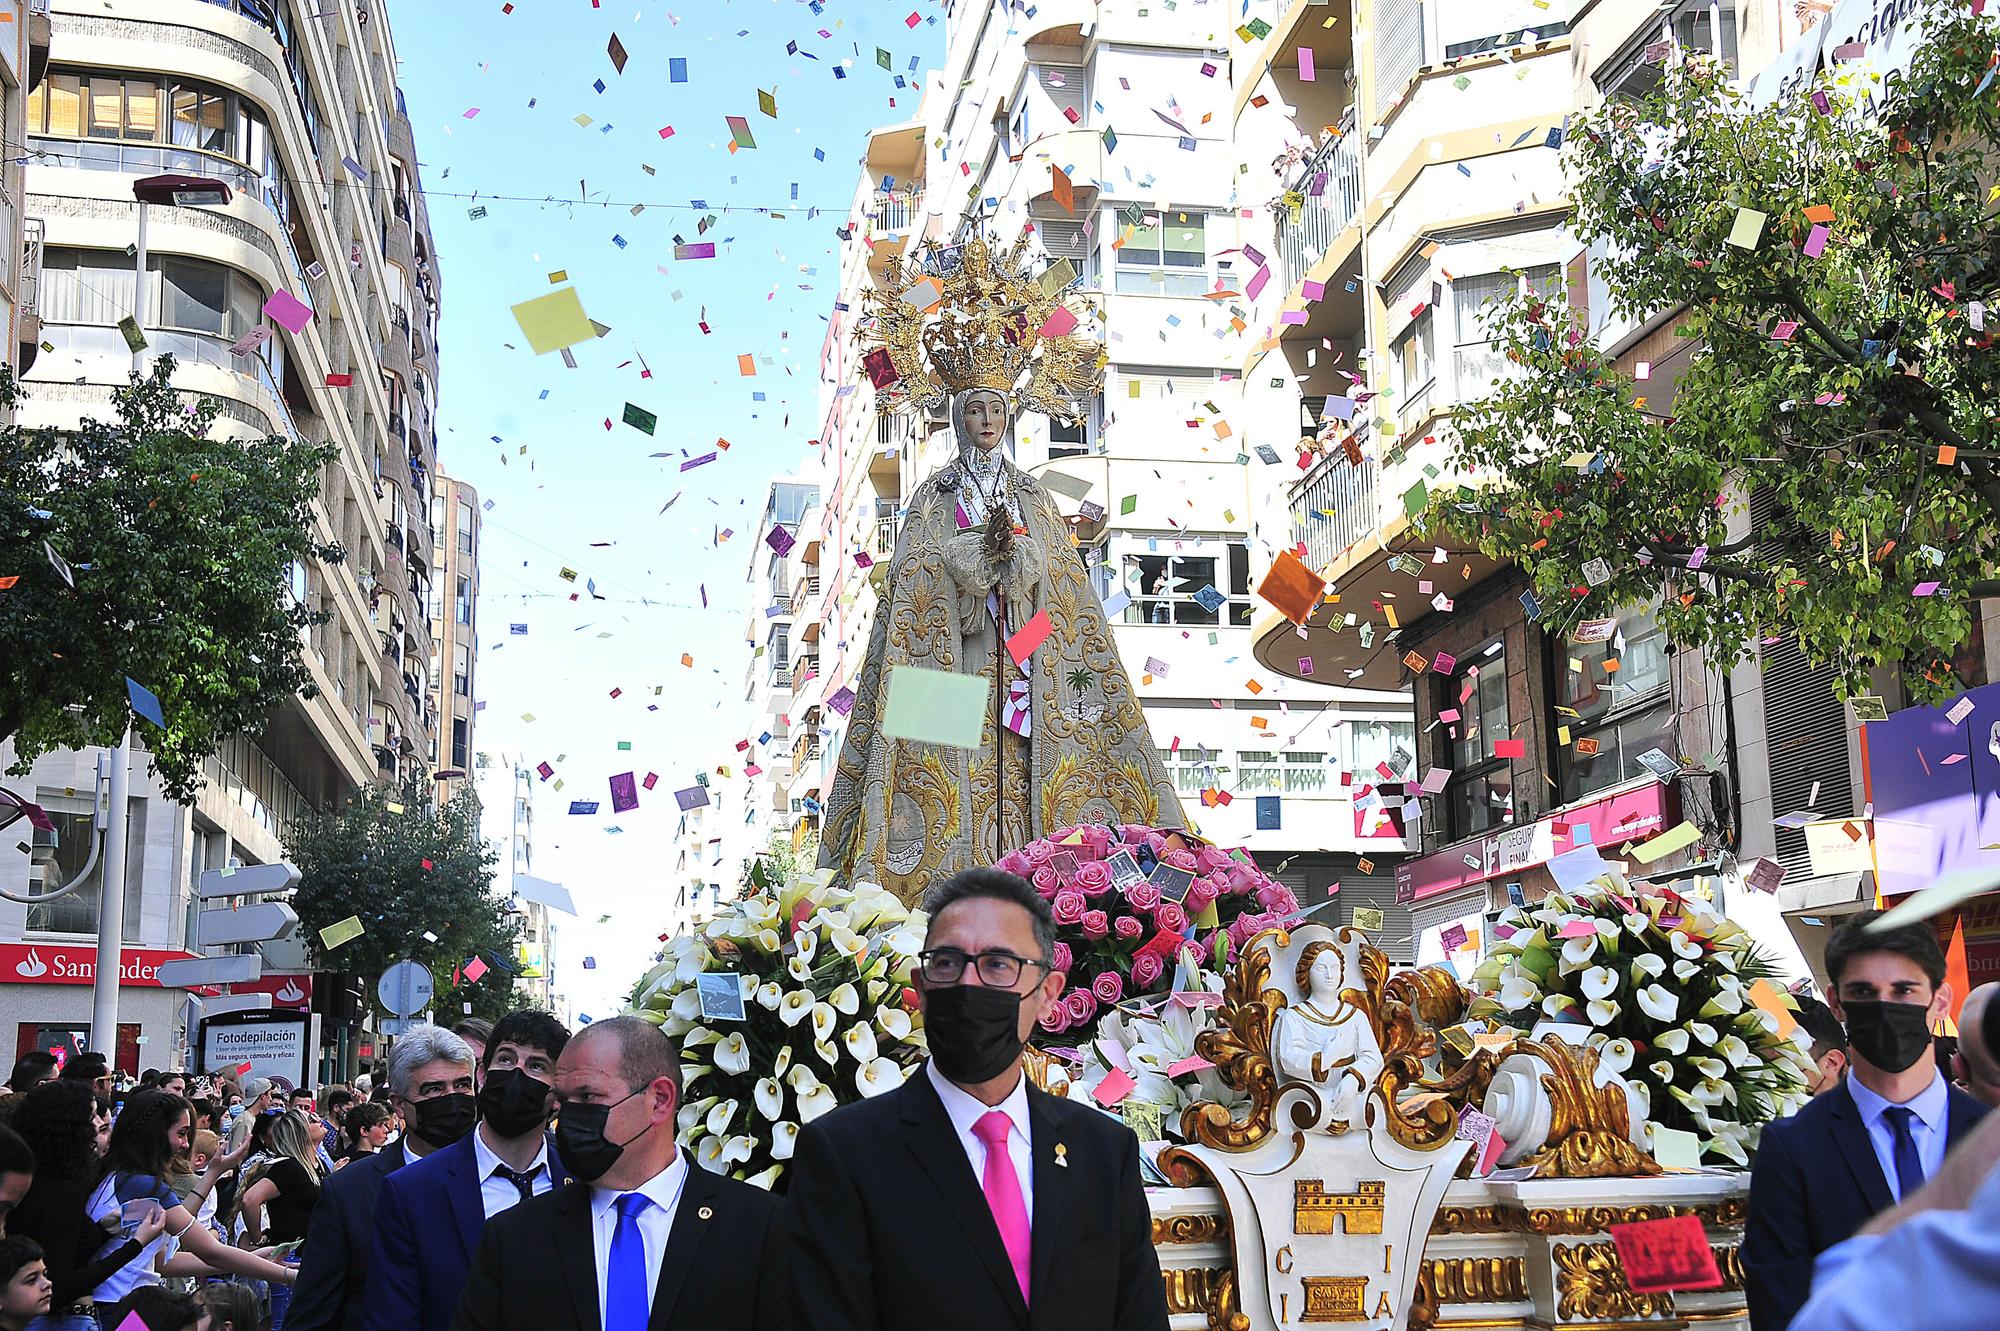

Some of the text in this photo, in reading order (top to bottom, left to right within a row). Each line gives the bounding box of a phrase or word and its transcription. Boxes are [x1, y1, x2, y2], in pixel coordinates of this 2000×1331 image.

[216, 1029, 296, 1045] Fotodepilación
[215, 1053, 227, 1061] Más
[228, 1054, 249, 1062] segura,
[249, 1052, 272, 1060] cómoda
[1275, 1244, 1294, 1275] C
[1372, 1290, 1394, 1320] A
